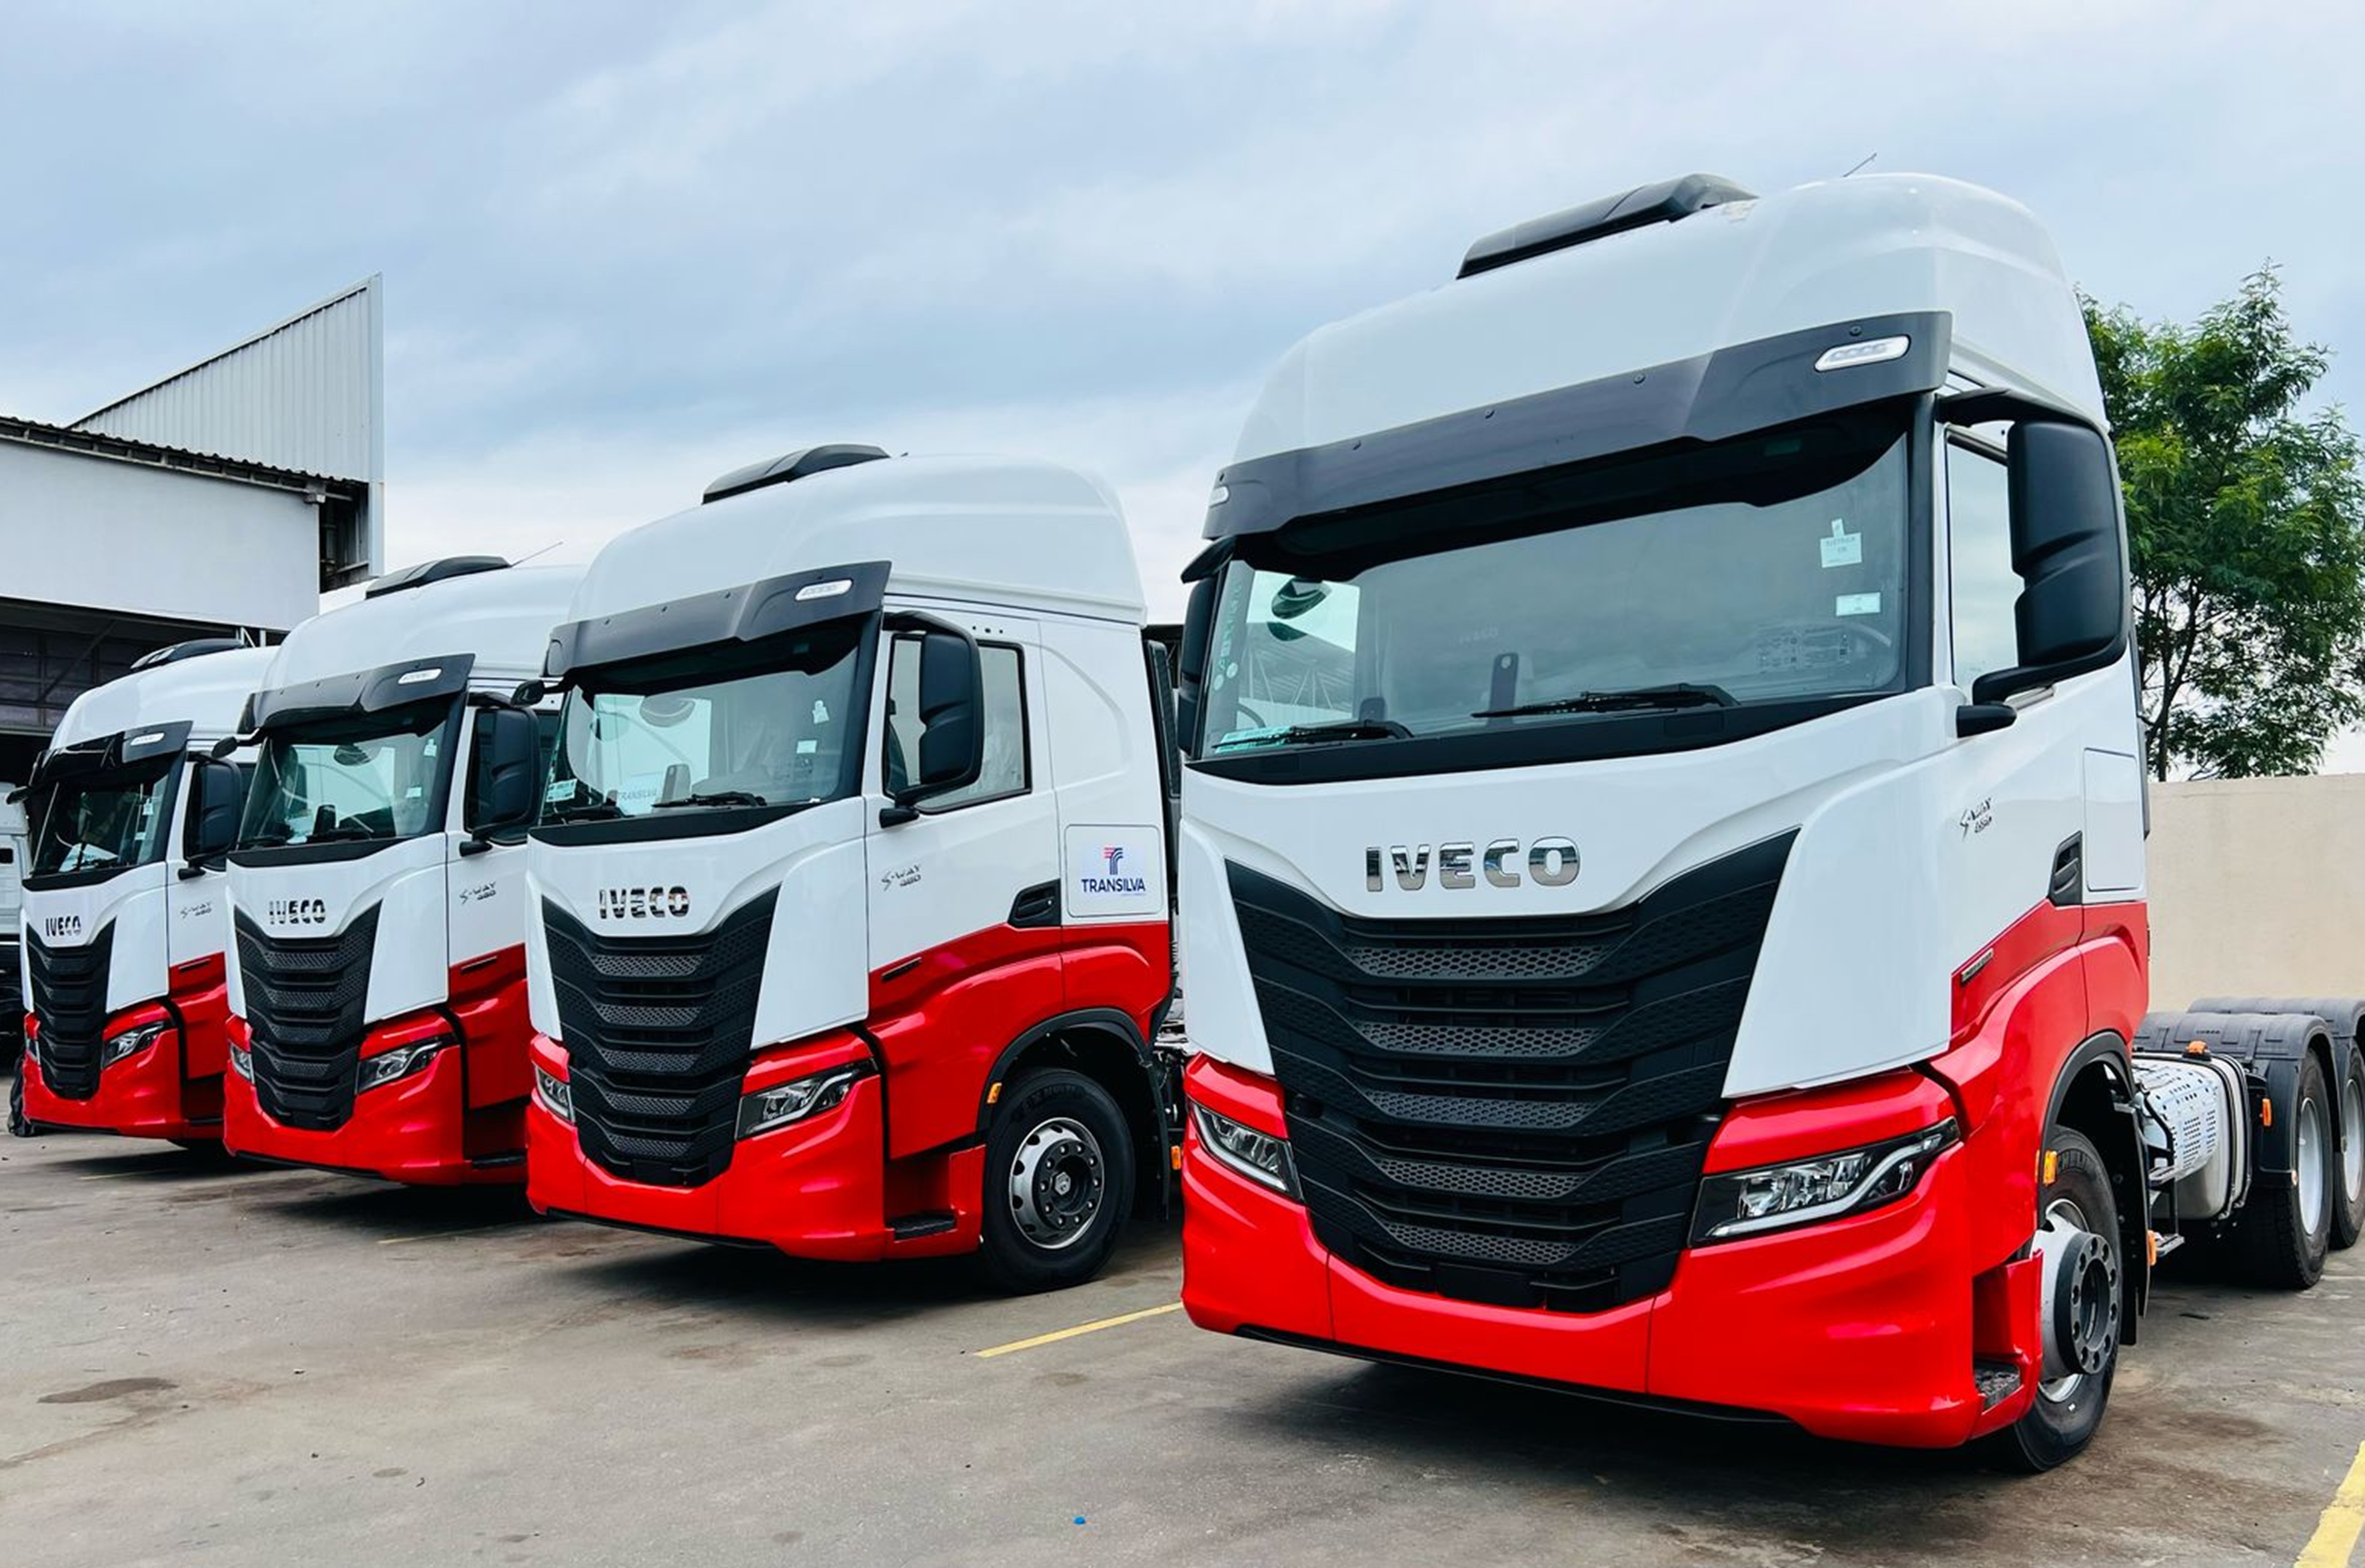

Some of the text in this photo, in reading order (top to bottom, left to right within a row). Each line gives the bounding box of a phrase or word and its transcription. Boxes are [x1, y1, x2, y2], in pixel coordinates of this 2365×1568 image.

[1365, 836, 1581, 892] IVECO
[1081, 878, 1146, 892] TRANSILVA
[269, 899, 326, 924] IVECO
[598, 886, 690, 919] IVECO
[45, 915, 81, 937] IVECO
